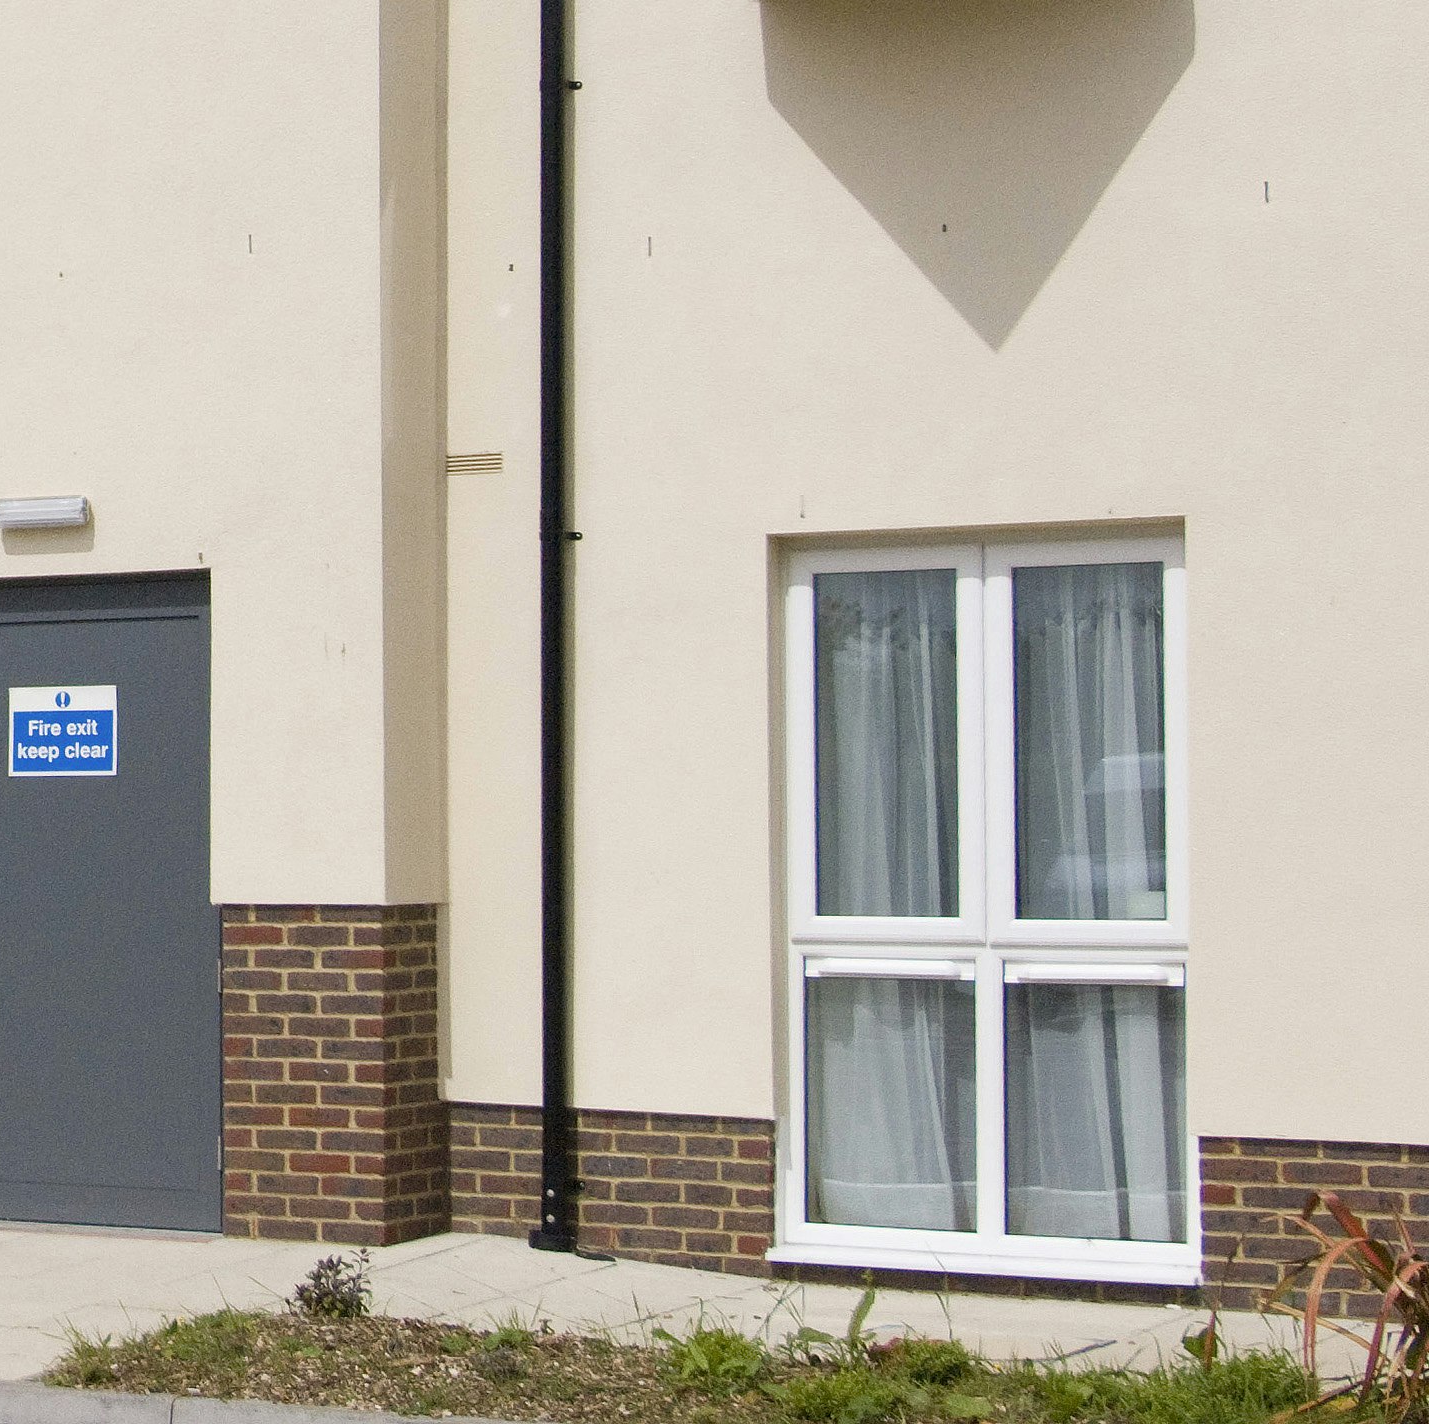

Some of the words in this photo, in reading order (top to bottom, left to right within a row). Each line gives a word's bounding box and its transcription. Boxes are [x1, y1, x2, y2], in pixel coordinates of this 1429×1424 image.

[27, 719, 62, 737] Fire
[65, 718, 100, 736] exit
[16, 741, 60, 763] keep
[63, 741, 109, 759] clear
